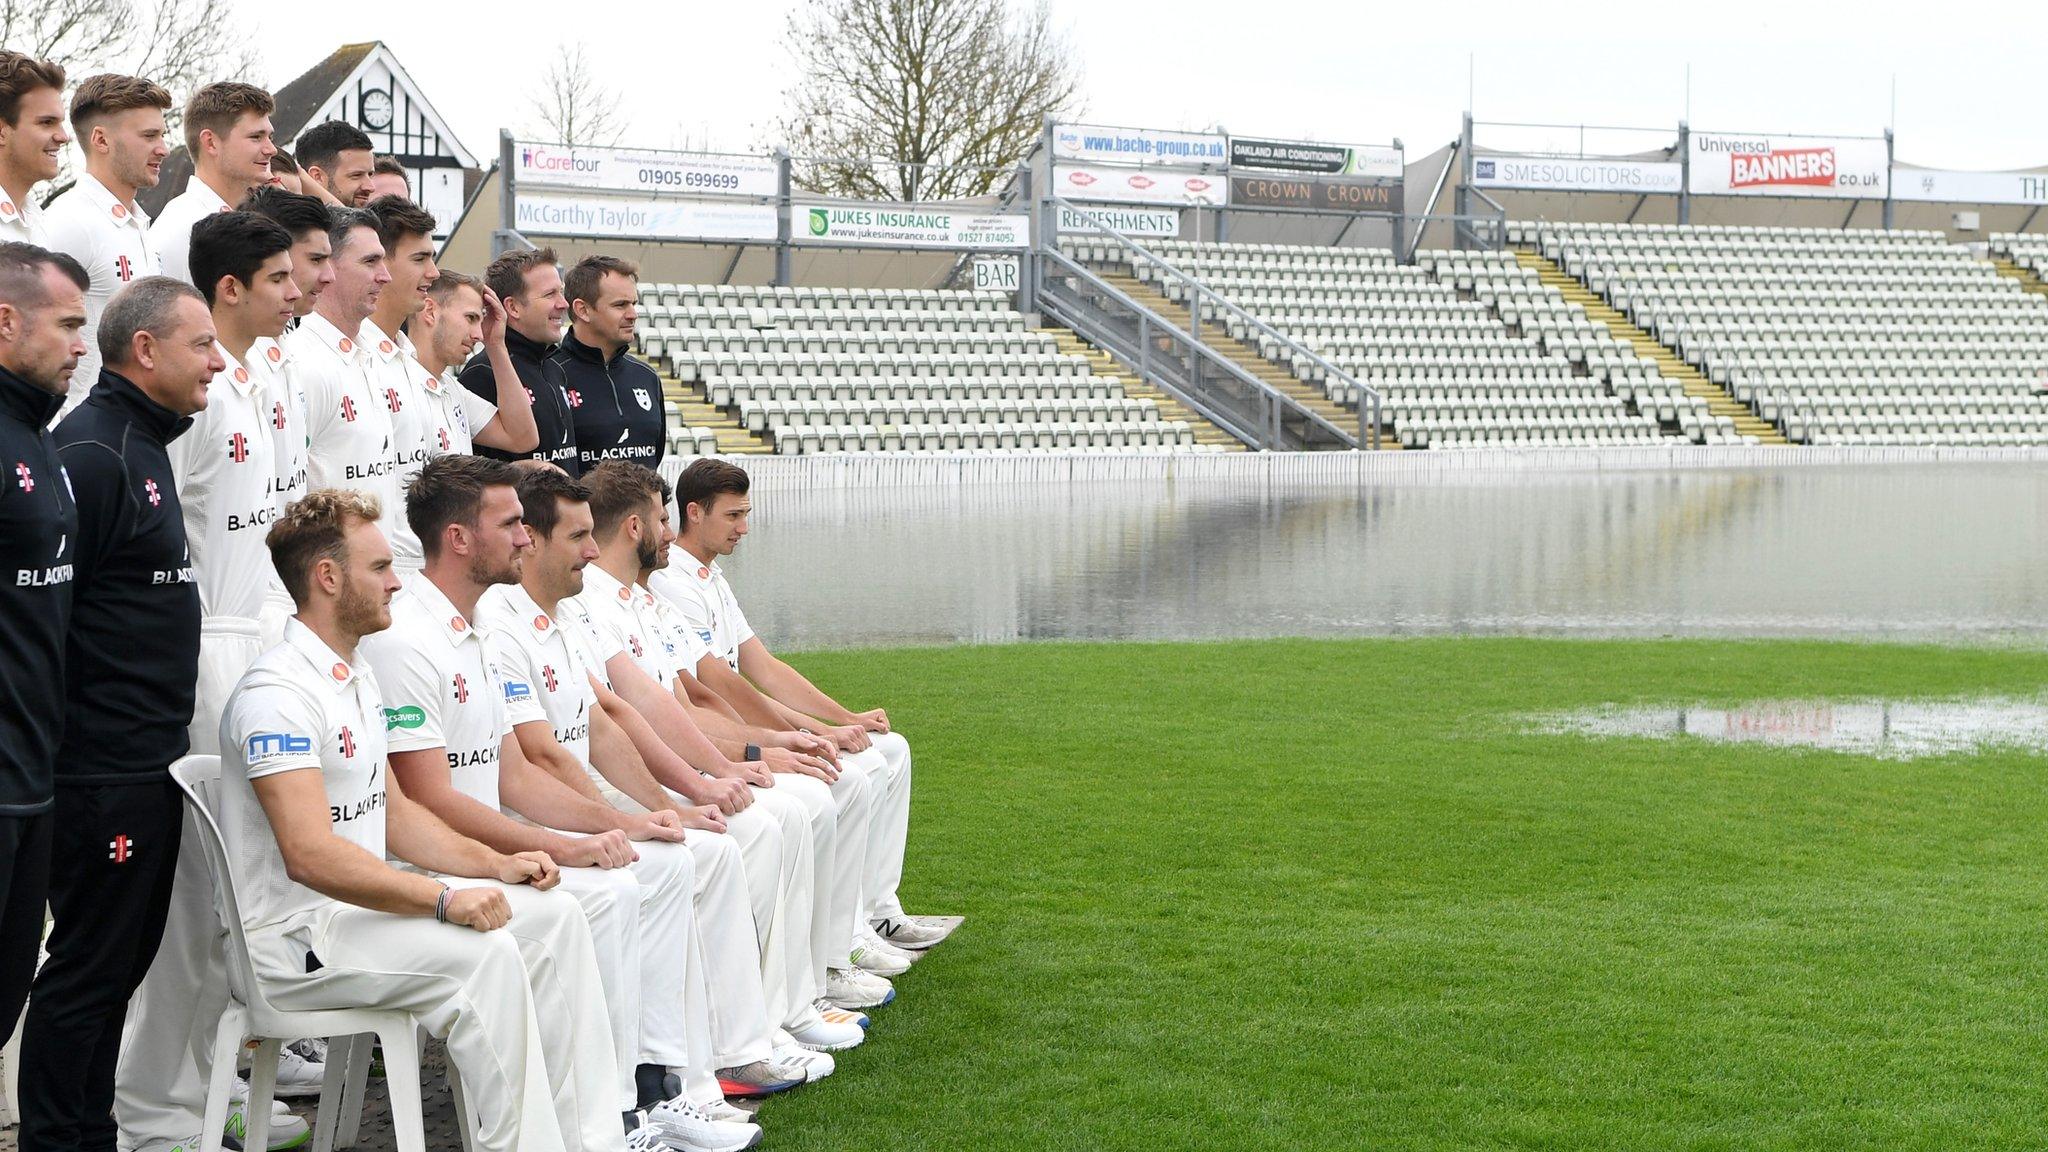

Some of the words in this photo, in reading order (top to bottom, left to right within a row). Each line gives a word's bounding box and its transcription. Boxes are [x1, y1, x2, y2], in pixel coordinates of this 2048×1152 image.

[1084, 136, 1223, 157] www.bache-group.co.uk
[1234, 145, 1271, 158] OAKLAND
[1273, 148, 1287, 159] AIR
[1288, 149, 1343, 163] CONDITIONING
[1699, 137, 1769, 154] Universal
[534, 150, 600, 172] Carefour
[1733, 152, 1835, 183] BANNERS
[638, 168, 682, 186] 01905
[685, 172, 738, 189] 699699
[1839, 172, 1880, 187] co.uk
[1246, 180, 1312, 200] CROWN
[1327, 184, 1389, 203] CROWN
[518, 203, 595, 230] McCarthy
[599, 206, 647, 231] Taylor
[831, 210, 872, 226] JUKES
[876, 212, 950, 229] INSURANCE
[831, 228, 950, 241] www.jukesinsurance.co.uk
[957, 232, 983, 243] 01527
[976, 263, 1016, 287] BAR
[447, 745, 500, 768] BLACK
